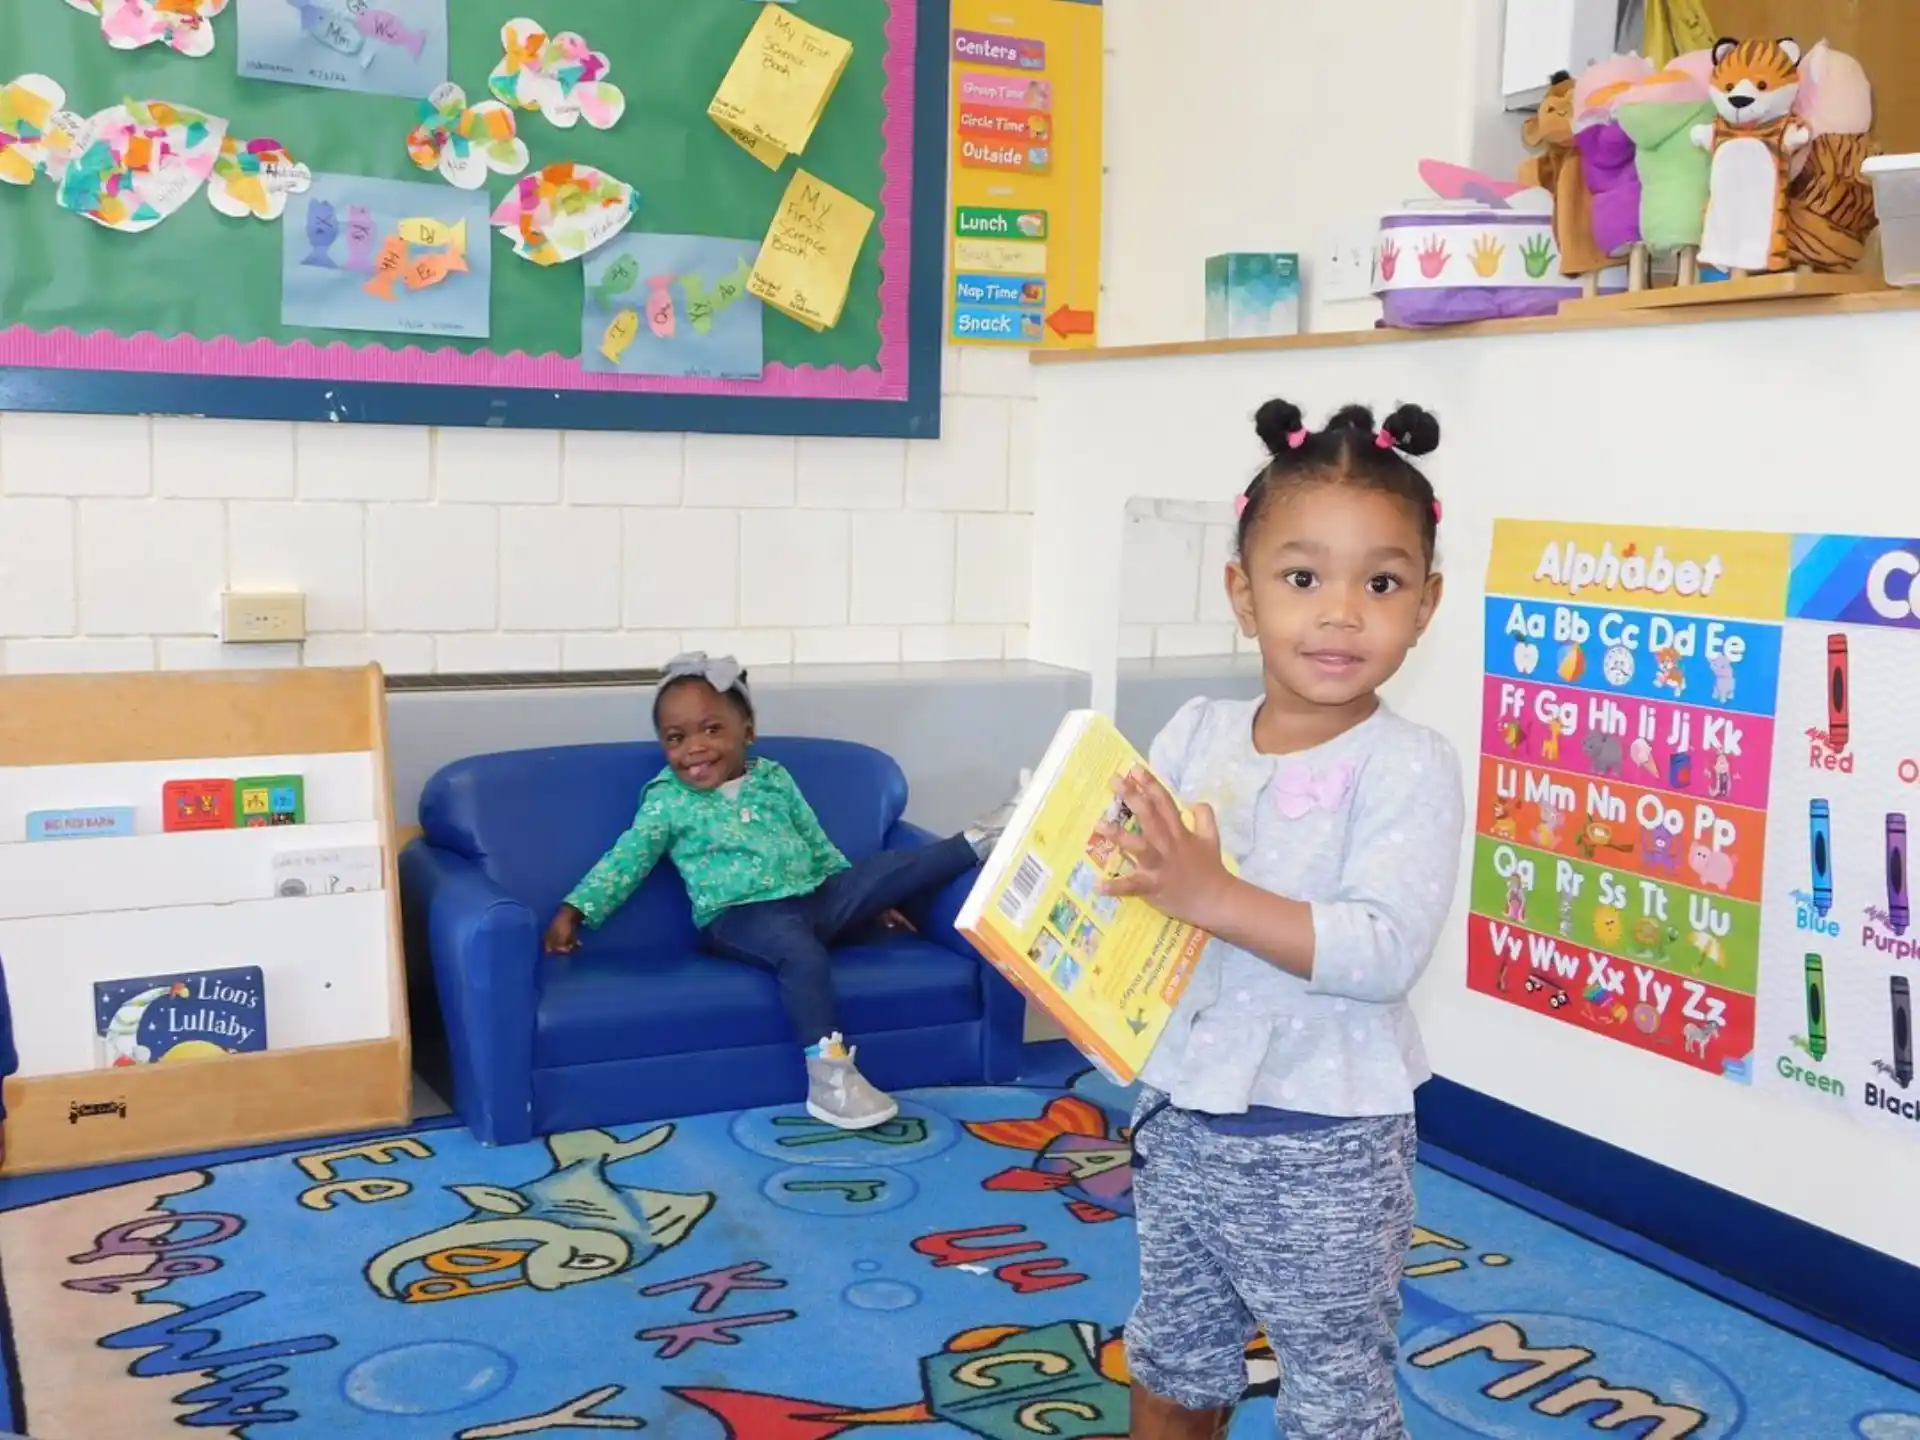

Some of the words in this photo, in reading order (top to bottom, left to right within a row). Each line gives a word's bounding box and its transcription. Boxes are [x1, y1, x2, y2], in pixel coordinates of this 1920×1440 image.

[774, 15, 796, 42] My
[956, 37, 1017, 60] Centers
[963, 81, 998, 98] Group
[997, 85, 1025, 98] Time
[961, 114, 993, 127] Circle
[996, 118, 1024, 132] Time
[963, 142, 1023, 165] Outside
[787, 201, 826, 233] First
[801, 184, 832, 220] My
[778, 219, 827, 255] Science
[960, 212, 1008, 232] Lunch
[957, 283, 984, 299] Nap
[986, 284, 1018, 300] Time
[958, 314, 1012, 333] Snack
[1532, 540, 1724, 597] Alphabet
[1866, 550, 1920, 620] C
[1505, 603, 1546, 638] Aa
[1554, 607, 1591, 645] Bb
[1599, 612, 1640, 650] Cc
[1648, 616, 1696, 657] Dd
[1706, 622, 1747, 663] Ee
[1500, 683, 1525, 719] Ff
[1533, 690, 1578, 735] Gg
[1588, 697, 1628, 736] Hh
[1667, 709, 1691, 753] Jj
[1702, 714, 1743, 756] Kk
[1809, 744, 1854, 774] Red
[1524, 766, 1576, 812] Mm
[1586, 781, 1626, 823] Nn
[1636, 793, 1685, 836] Oo
[1694, 803, 1737, 854] Pp
[1493, 845, 1535, 892] Qq
[1555, 859, 1585, 898] Rr
[1598, 871, 1627, 909] Ss
[1638, 880, 1669, 922] Tt
[1688, 893, 1732, 937] Uu
[1796, 907, 1841, 938] Blue
[1488, 920, 1523, 962] Vv
[1528, 933, 1580, 980] Ww
[1586, 951, 1625, 996] Xx
[1632, 965, 1672, 1015] Yy
[1681, 979, 1727, 1028] Zz
[198, 977, 259, 1009] Lion's
[168, 1007, 256, 1045] Lullaby
[1776, 1054, 1845, 1098] Green
